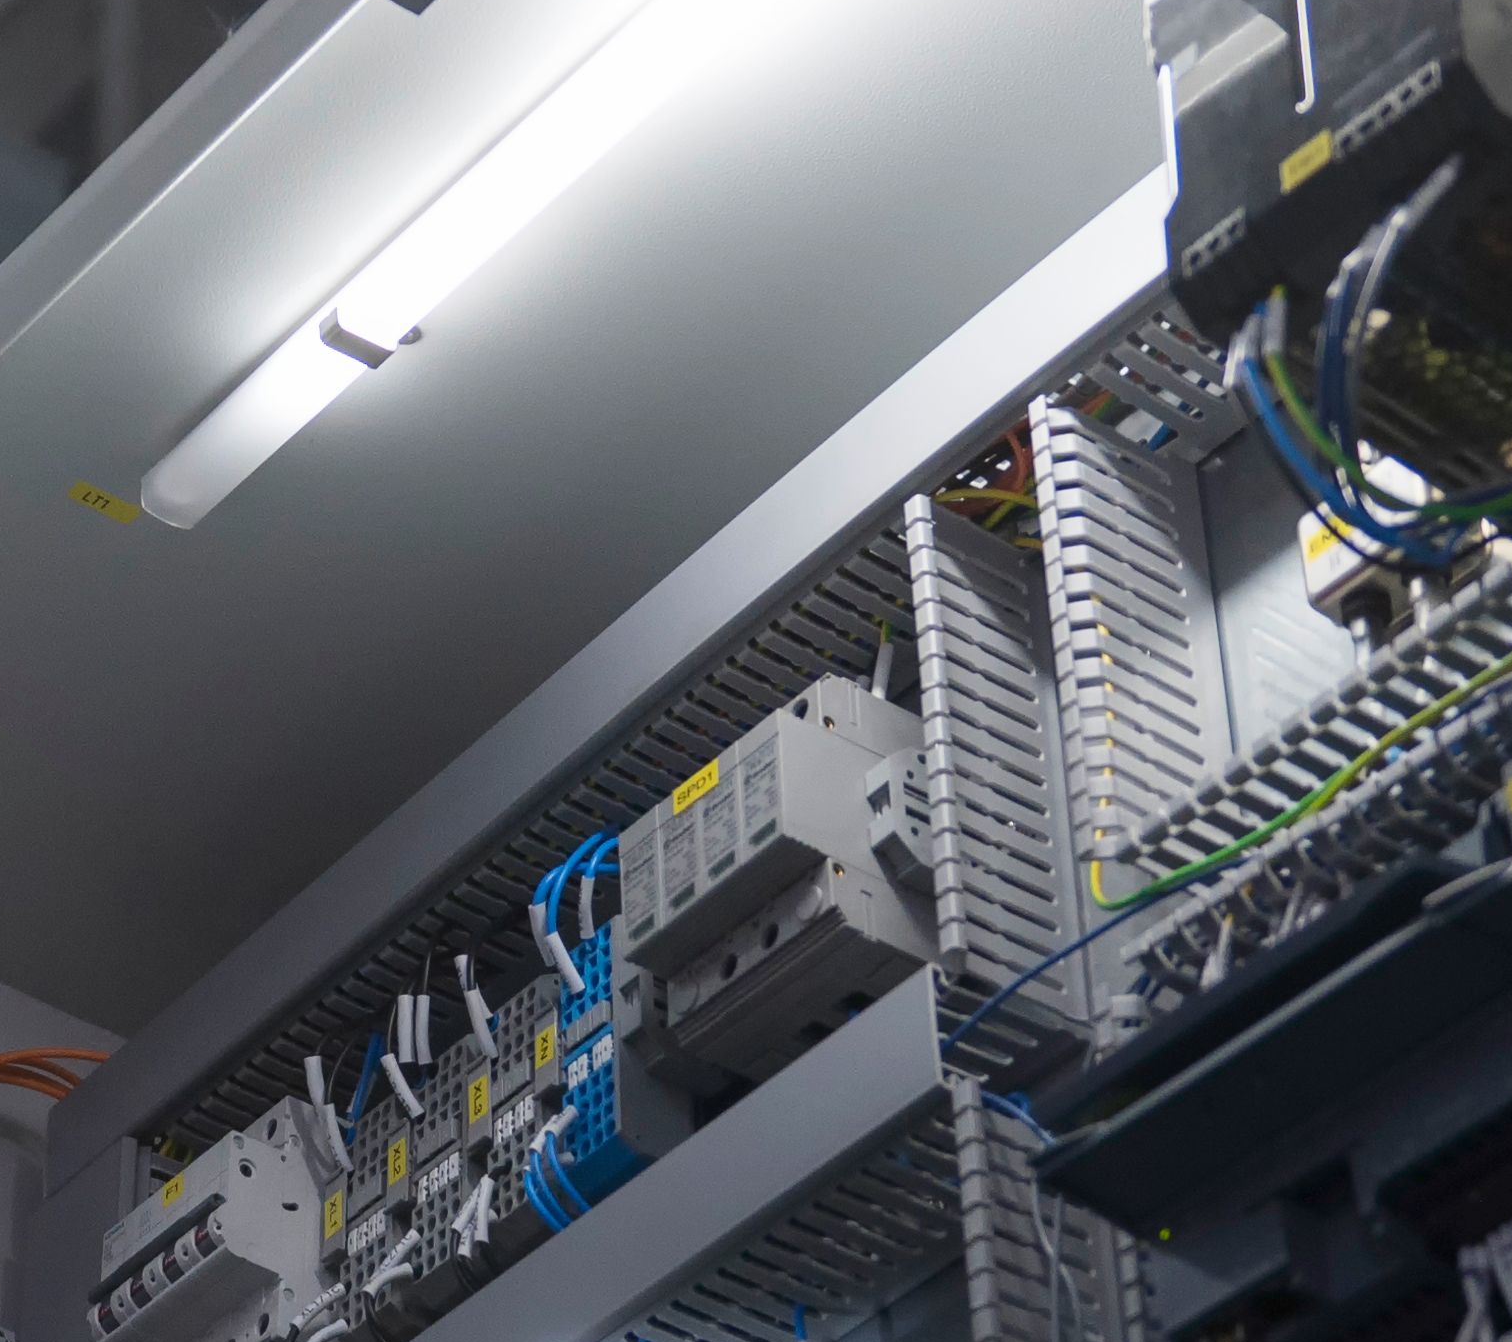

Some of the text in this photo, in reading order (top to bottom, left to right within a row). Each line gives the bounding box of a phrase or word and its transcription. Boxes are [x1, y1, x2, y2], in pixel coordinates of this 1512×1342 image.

[81, 491, 110, 509] LT1
[677, 771, 712, 805] SPD1
[474, 1081, 483, 1116] XL3
[393, 1144, 401, 1178] XL2
[166, 1182, 178, 1200] F1
[329, 1197, 338, 1229] XL1
